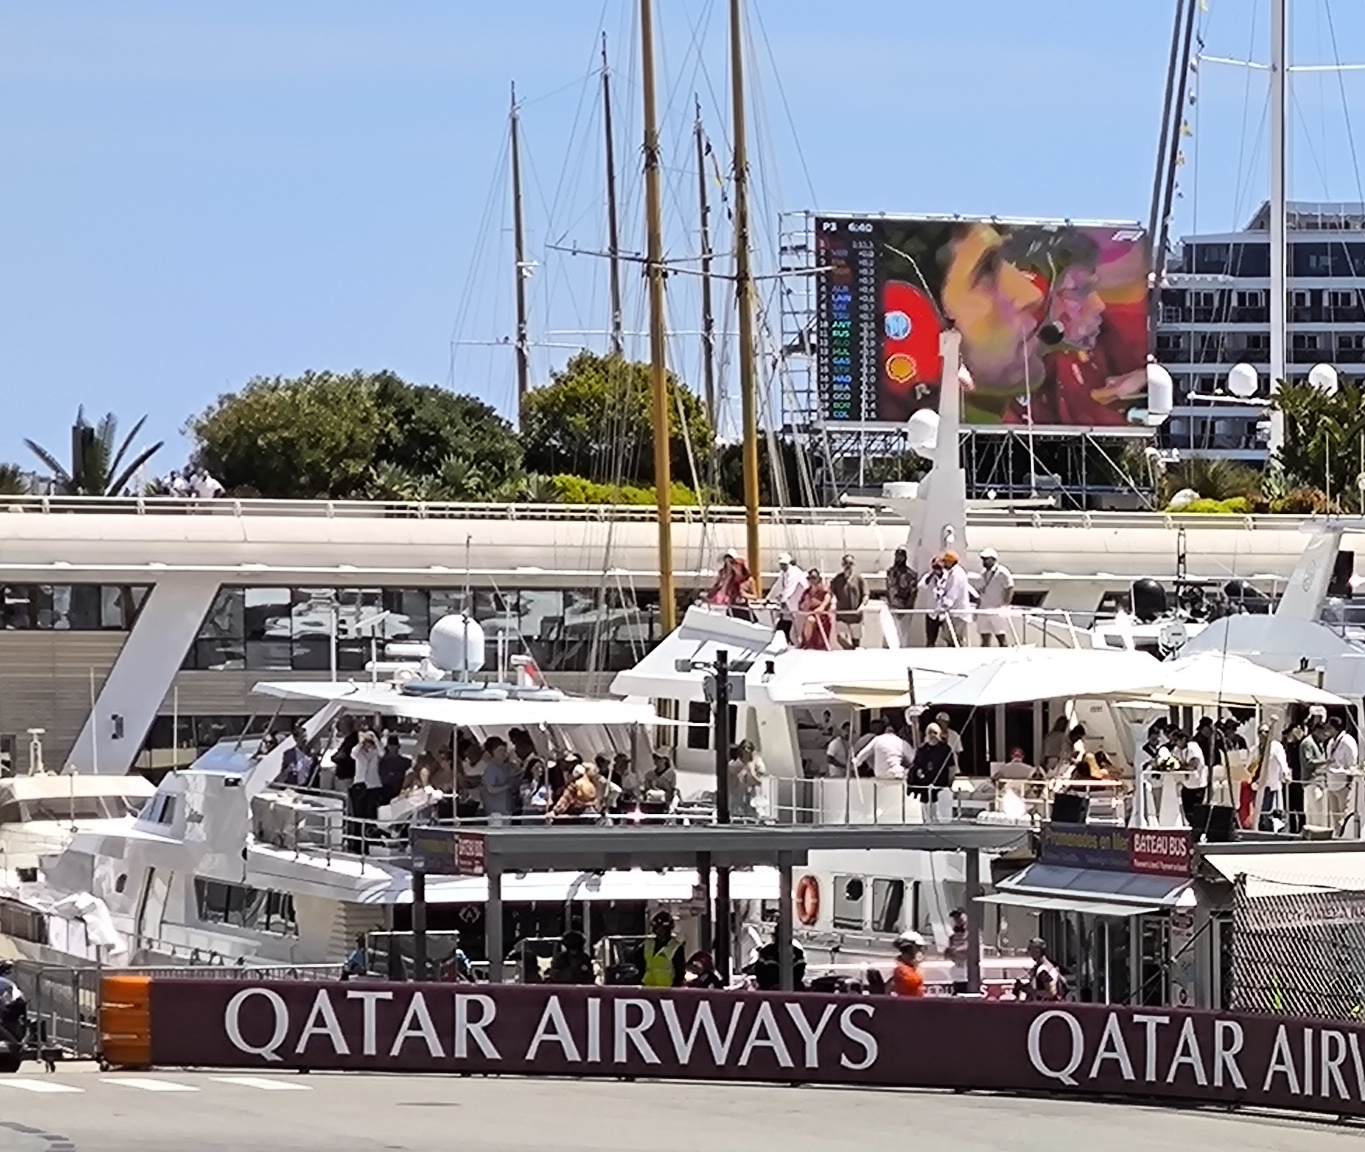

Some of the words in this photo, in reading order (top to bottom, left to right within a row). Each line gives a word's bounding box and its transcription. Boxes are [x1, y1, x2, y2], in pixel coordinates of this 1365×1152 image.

[833, 392, 851, 400] OCO
[833, 410, 850, 418] COL
[1133, 833, 1168, 855] BATEAU
[1168, 836, 1187, 857] BUS
[226, 988, 502, 1060] QATAR
[526, 991, 879, 1070] AIRWAYS
[1027, 1010, 1248, 1090] QATAR
